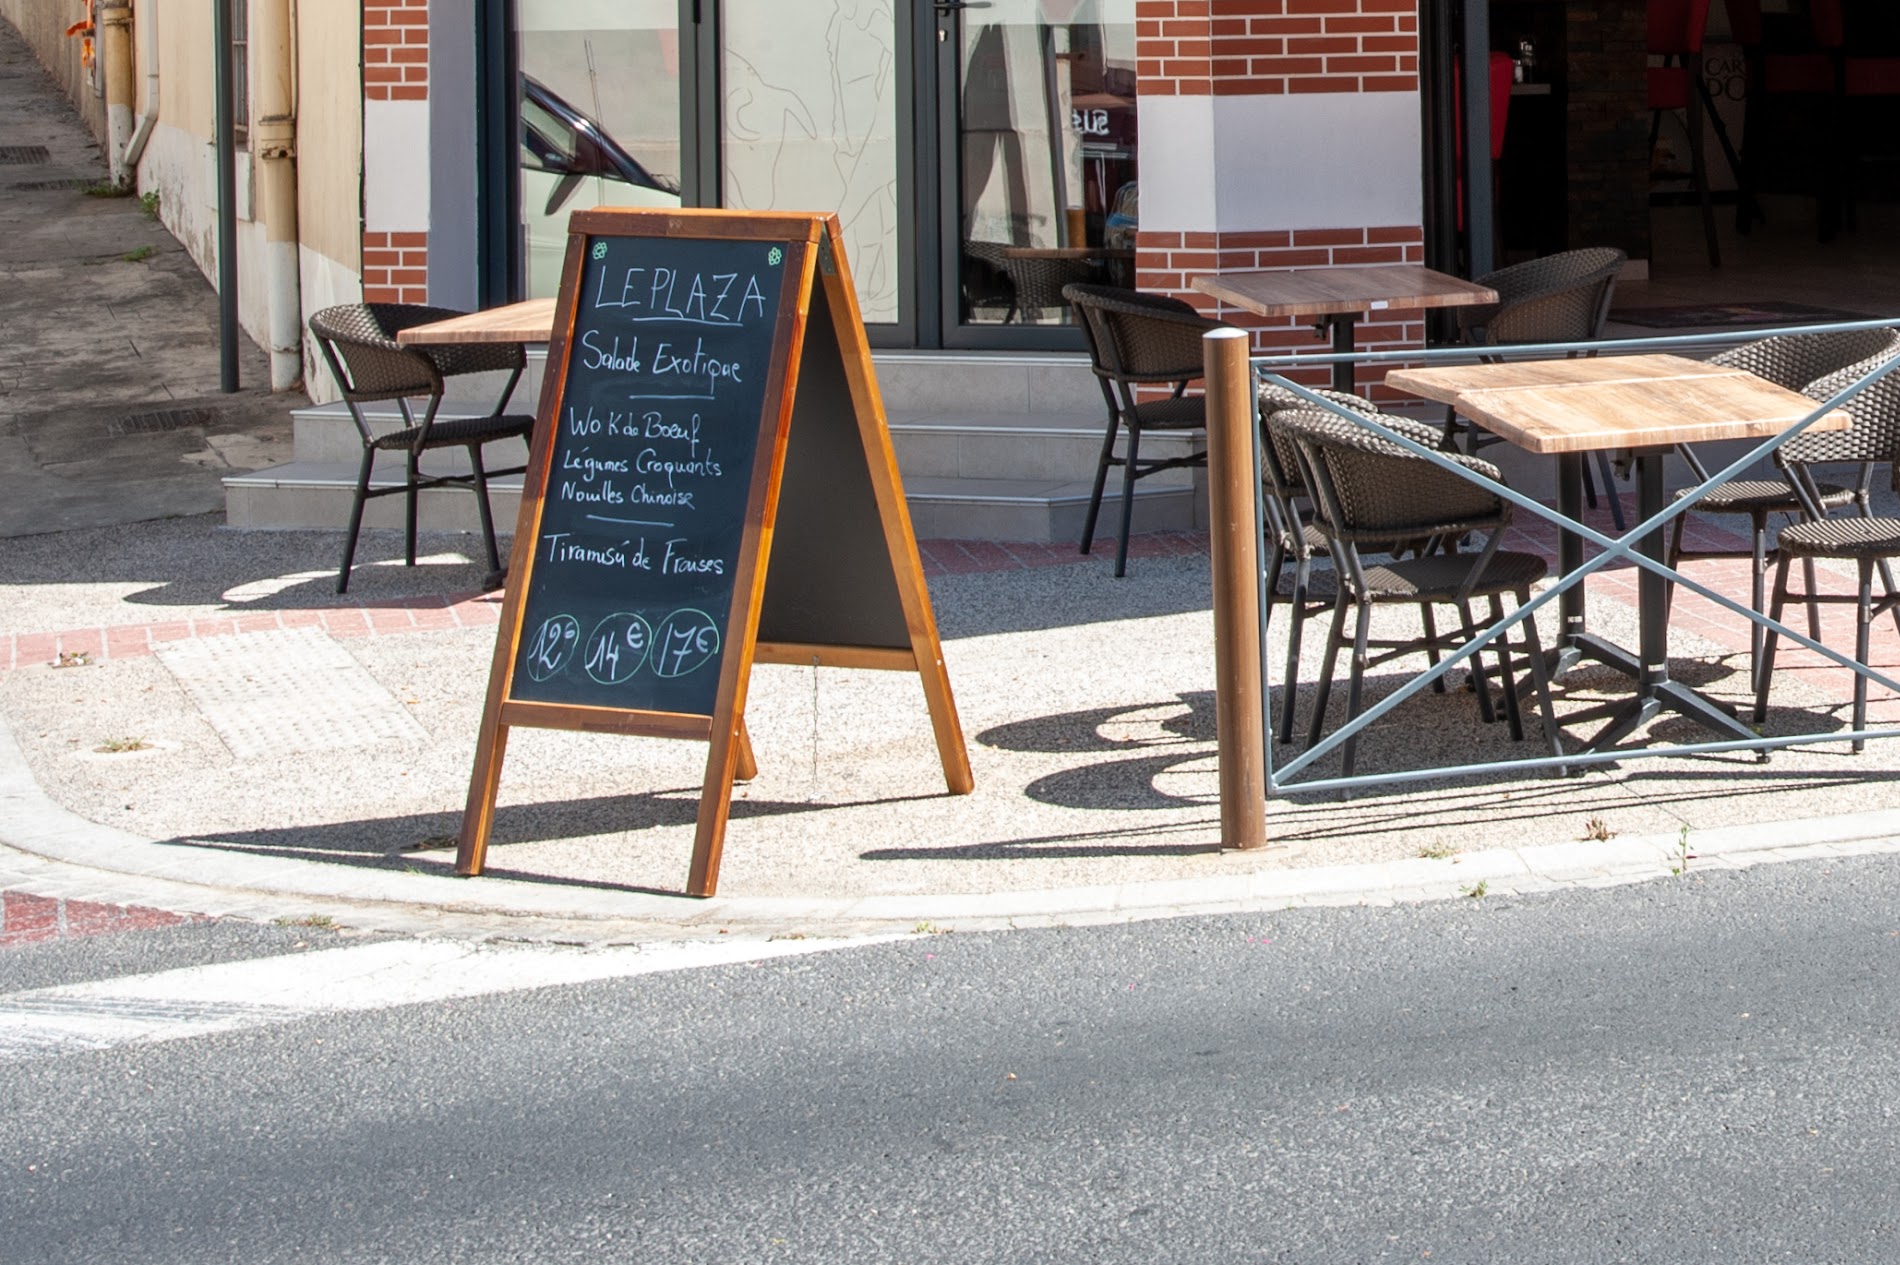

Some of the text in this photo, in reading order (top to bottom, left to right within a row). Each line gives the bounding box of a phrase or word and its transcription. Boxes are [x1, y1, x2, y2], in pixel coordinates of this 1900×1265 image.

[595, 265, 767, 322] LE PLAZA
[582, 329, 742, 395] Salade Exotique
[563, 447, 722, 488] Légumes Croquants
[561, 481, 695, 510] Nouilles Chinoise
[632, 537, 651, 570] de
[662, 538, 724, 575] Fraises
